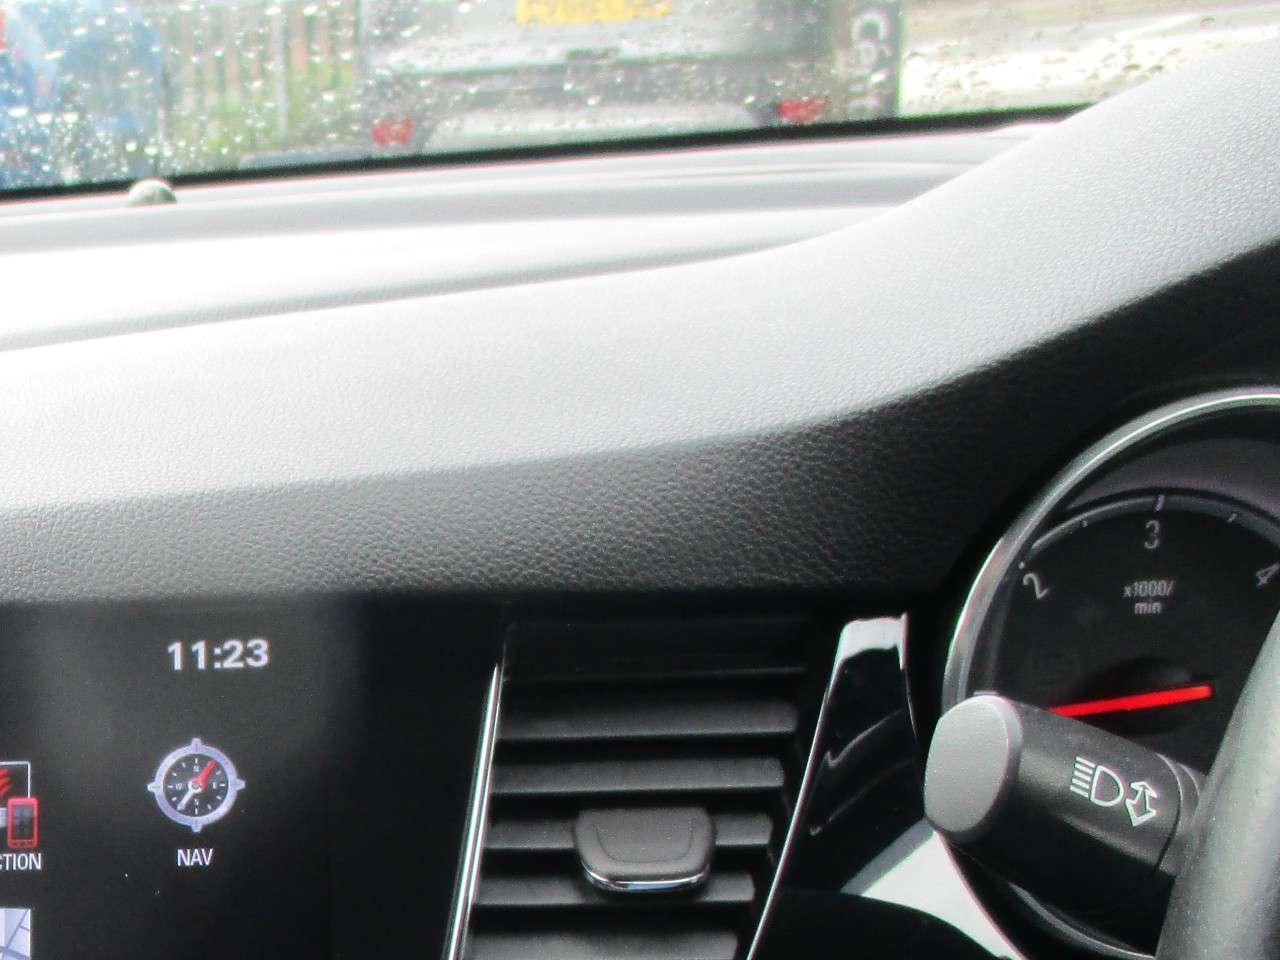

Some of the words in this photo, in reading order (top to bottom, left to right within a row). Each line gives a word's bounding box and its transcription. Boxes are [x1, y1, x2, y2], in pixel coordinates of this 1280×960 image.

[1144, 520, 1161, 549] 3
[1022, 572, 1049, 600] 2
[1255, 562, 1280, 587] 4
[1134, 602, 1162, 615] min
[166, 638, 270, 671] 11:23
[176, 847, 214, 867] NAV
